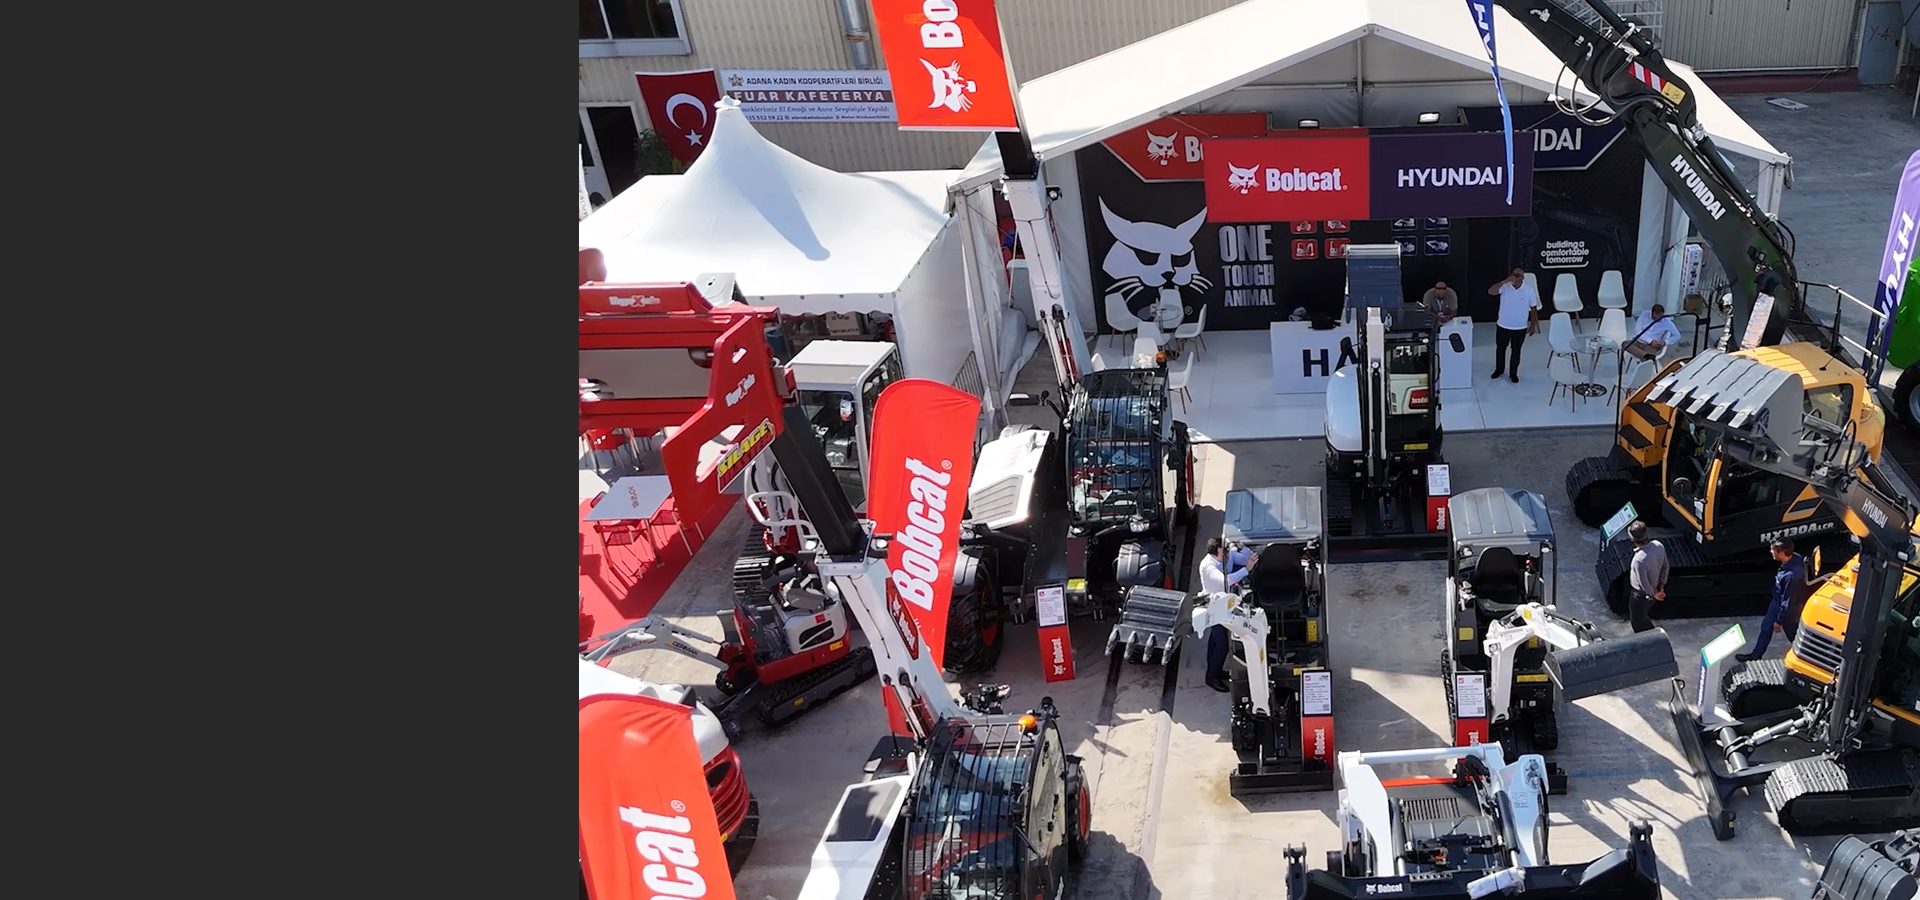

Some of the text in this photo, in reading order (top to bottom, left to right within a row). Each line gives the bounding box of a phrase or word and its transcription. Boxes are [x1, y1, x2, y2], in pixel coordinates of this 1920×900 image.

[919, 0, 965, 48] Bo
[746, 77, 773, 85] ADANA
[774, 77, 797, 85] KADIN
[733, 91, 885, 101] FUAR KAFETERYA
[1533, 127, 1582, 151] DAI
[1265, 167, 1342, 192] Bobcat
[1398, 166, 1503, 187] HYUNDAI
[1670, 153, 1726, 220] HYUNDAI
[1218, 225, 1273, 262] ONE
[1540, 247, 1590, 257] comfortable
[1546, 240, 1578, 249] building
[1546, 256, 1584, 264] tomorrow
[1221, 264, 1275, 287] TOUGH
[1224, 289, 1277, 307] ANIMAL
[1862, 497, 1889, 529] HYUNDAI
[892, 457, 951, 611] Bobcat
[619, 806, 707, 900] cat
[1377, 883, 1403, 893] Bobcat
